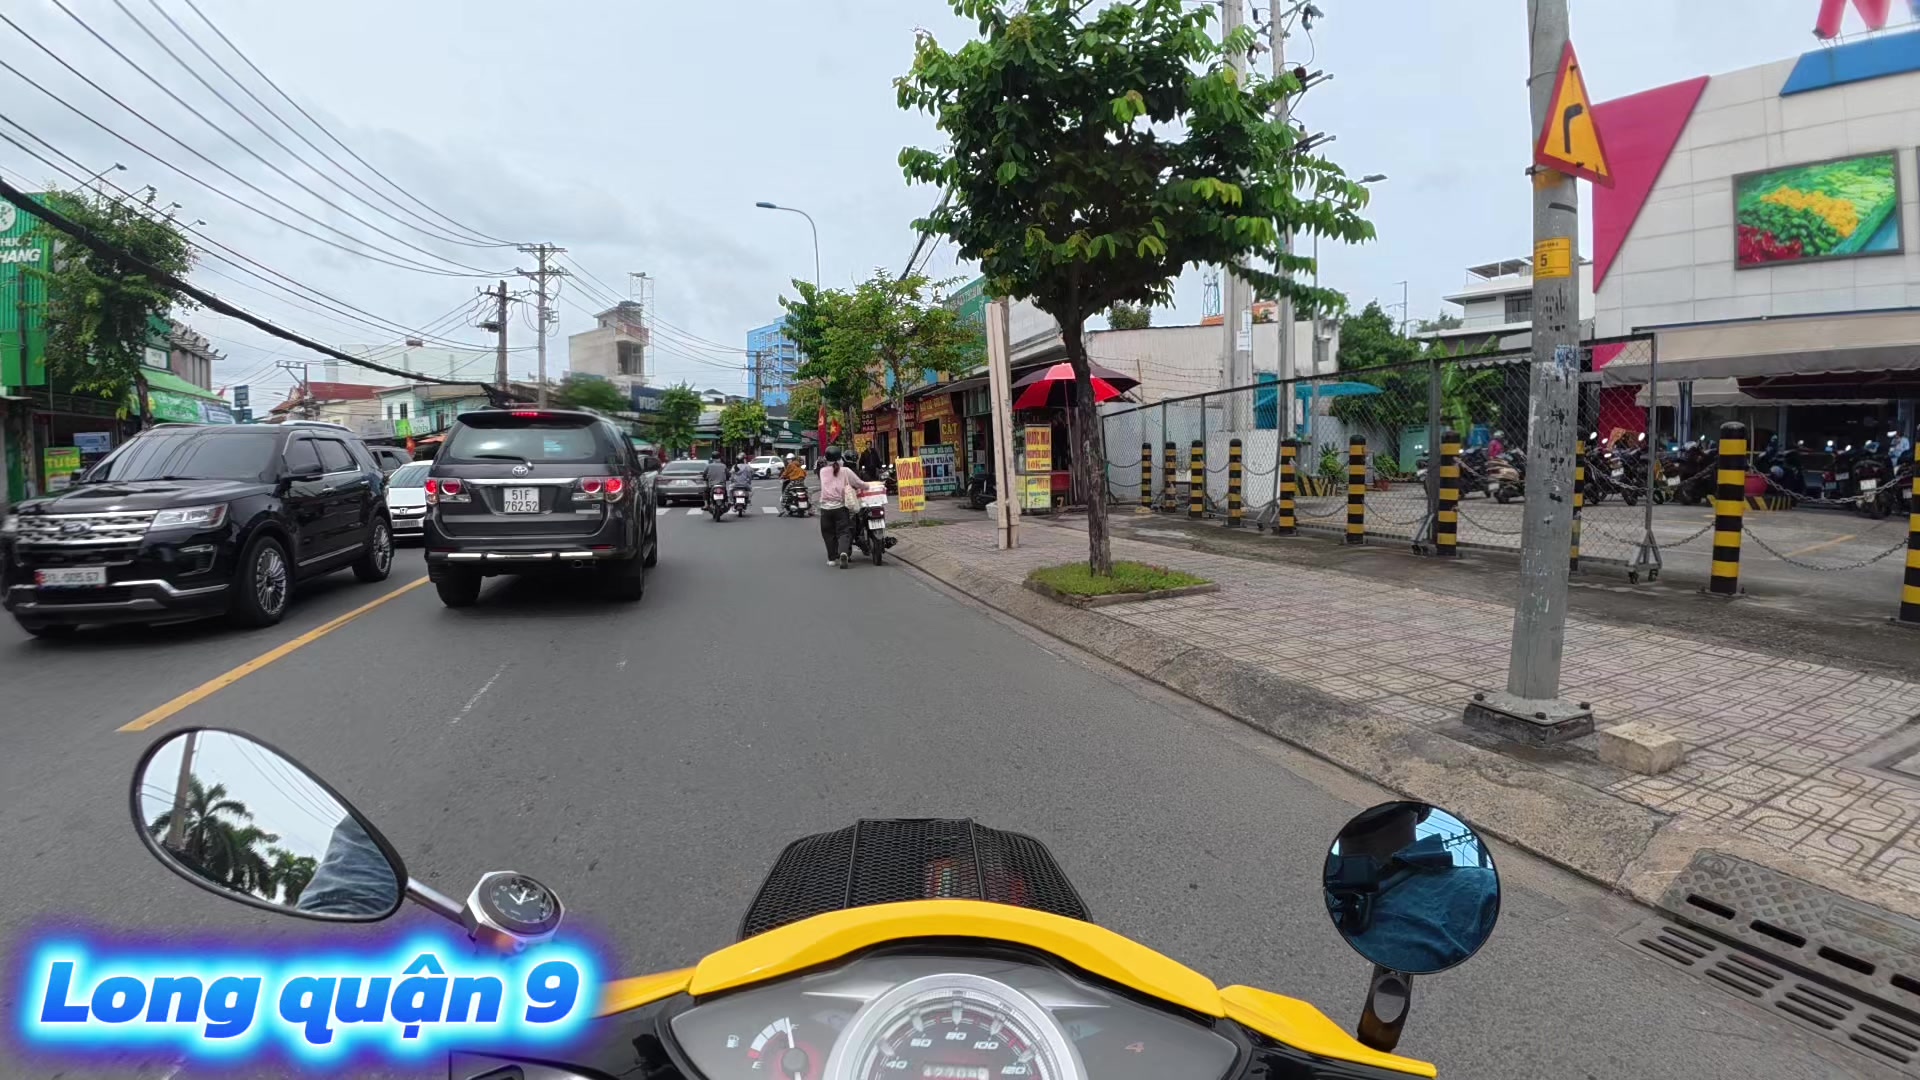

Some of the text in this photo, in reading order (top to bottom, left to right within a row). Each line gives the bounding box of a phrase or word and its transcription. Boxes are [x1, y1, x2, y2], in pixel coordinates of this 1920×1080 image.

[1540, 253, 1548, 267] 5
[512, 489, 530, 500] 51F
[945, 1031, 968, 1041] 80
[973, 1041, 999, 1050] 100
[885, 1059, 908, 1070] 40
[1001, 1065, 1027, 1075] 120
